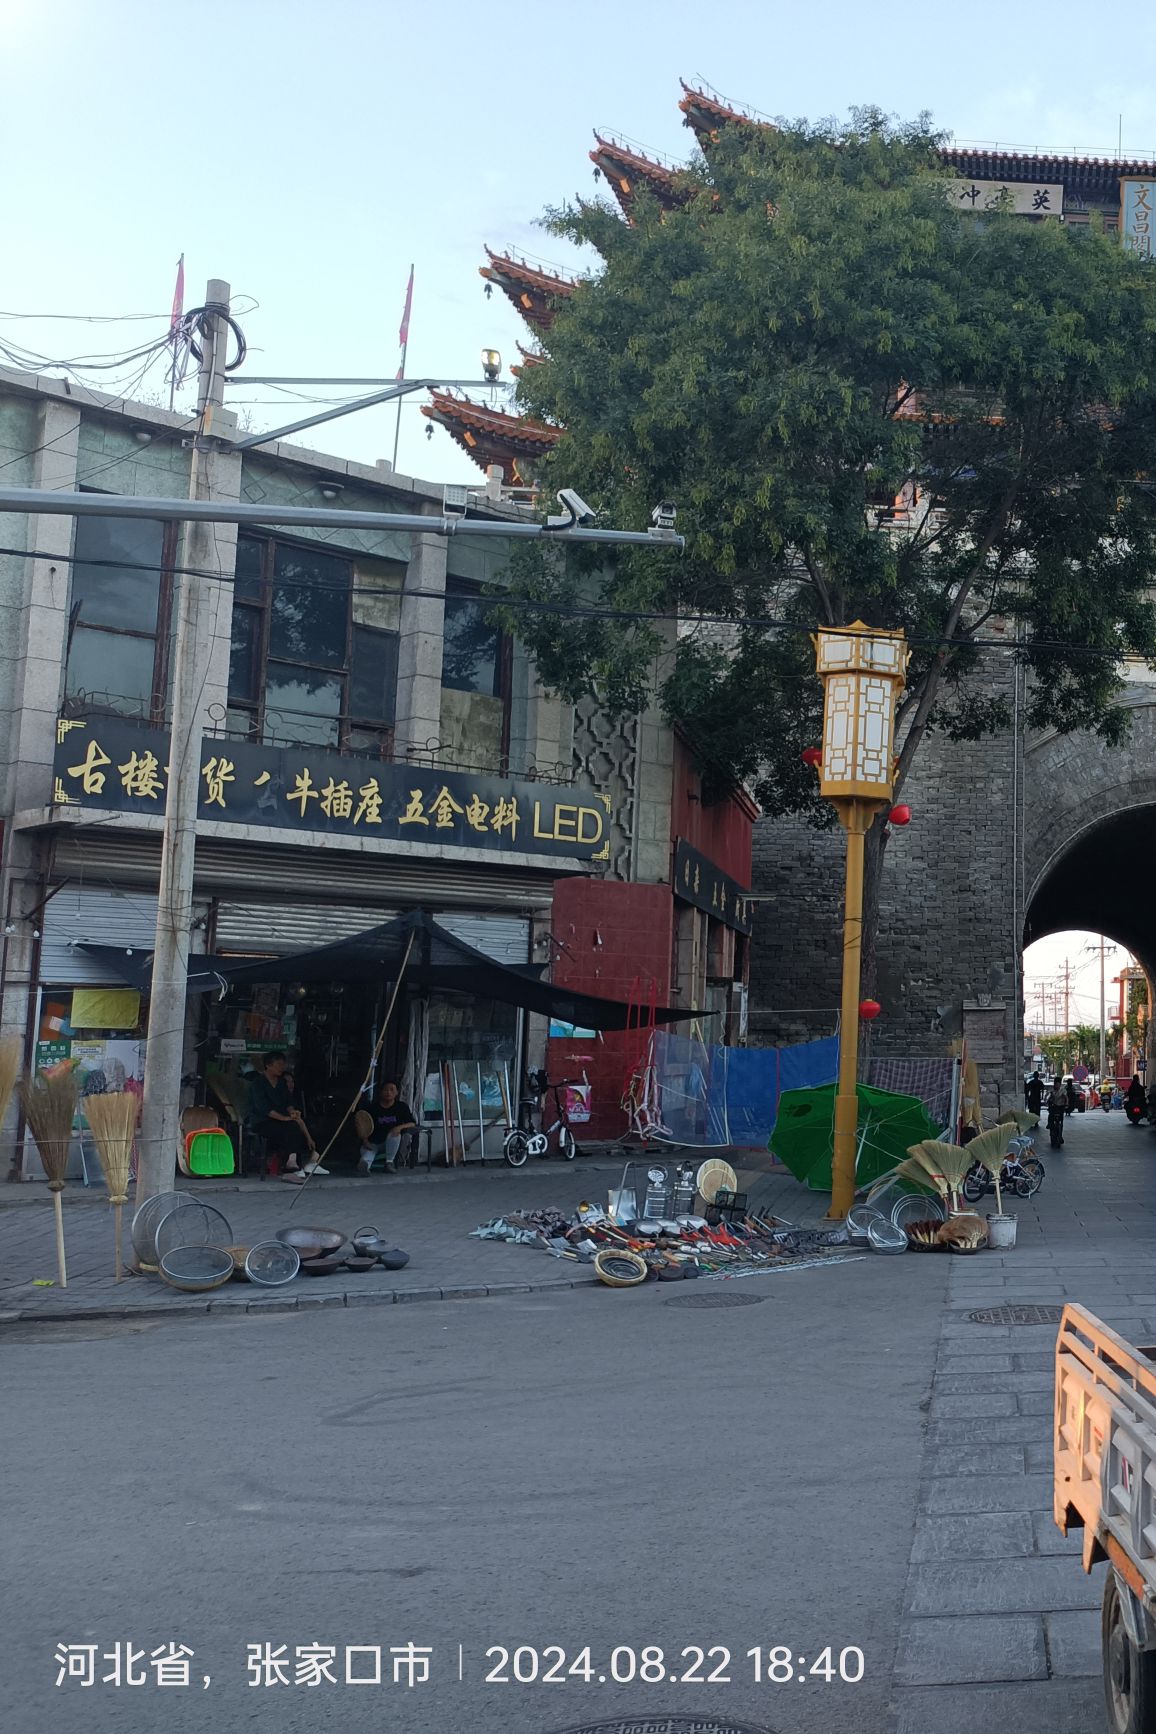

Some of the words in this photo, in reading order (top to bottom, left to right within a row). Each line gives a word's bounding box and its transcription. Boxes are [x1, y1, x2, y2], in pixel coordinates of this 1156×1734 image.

[1131, 184, 1154, 258] 文昌閣
[67, 740, 235, 808] 古楼货
[398, 785, 521, 842] 五金电料
[533, 801, 603, 844] LED
